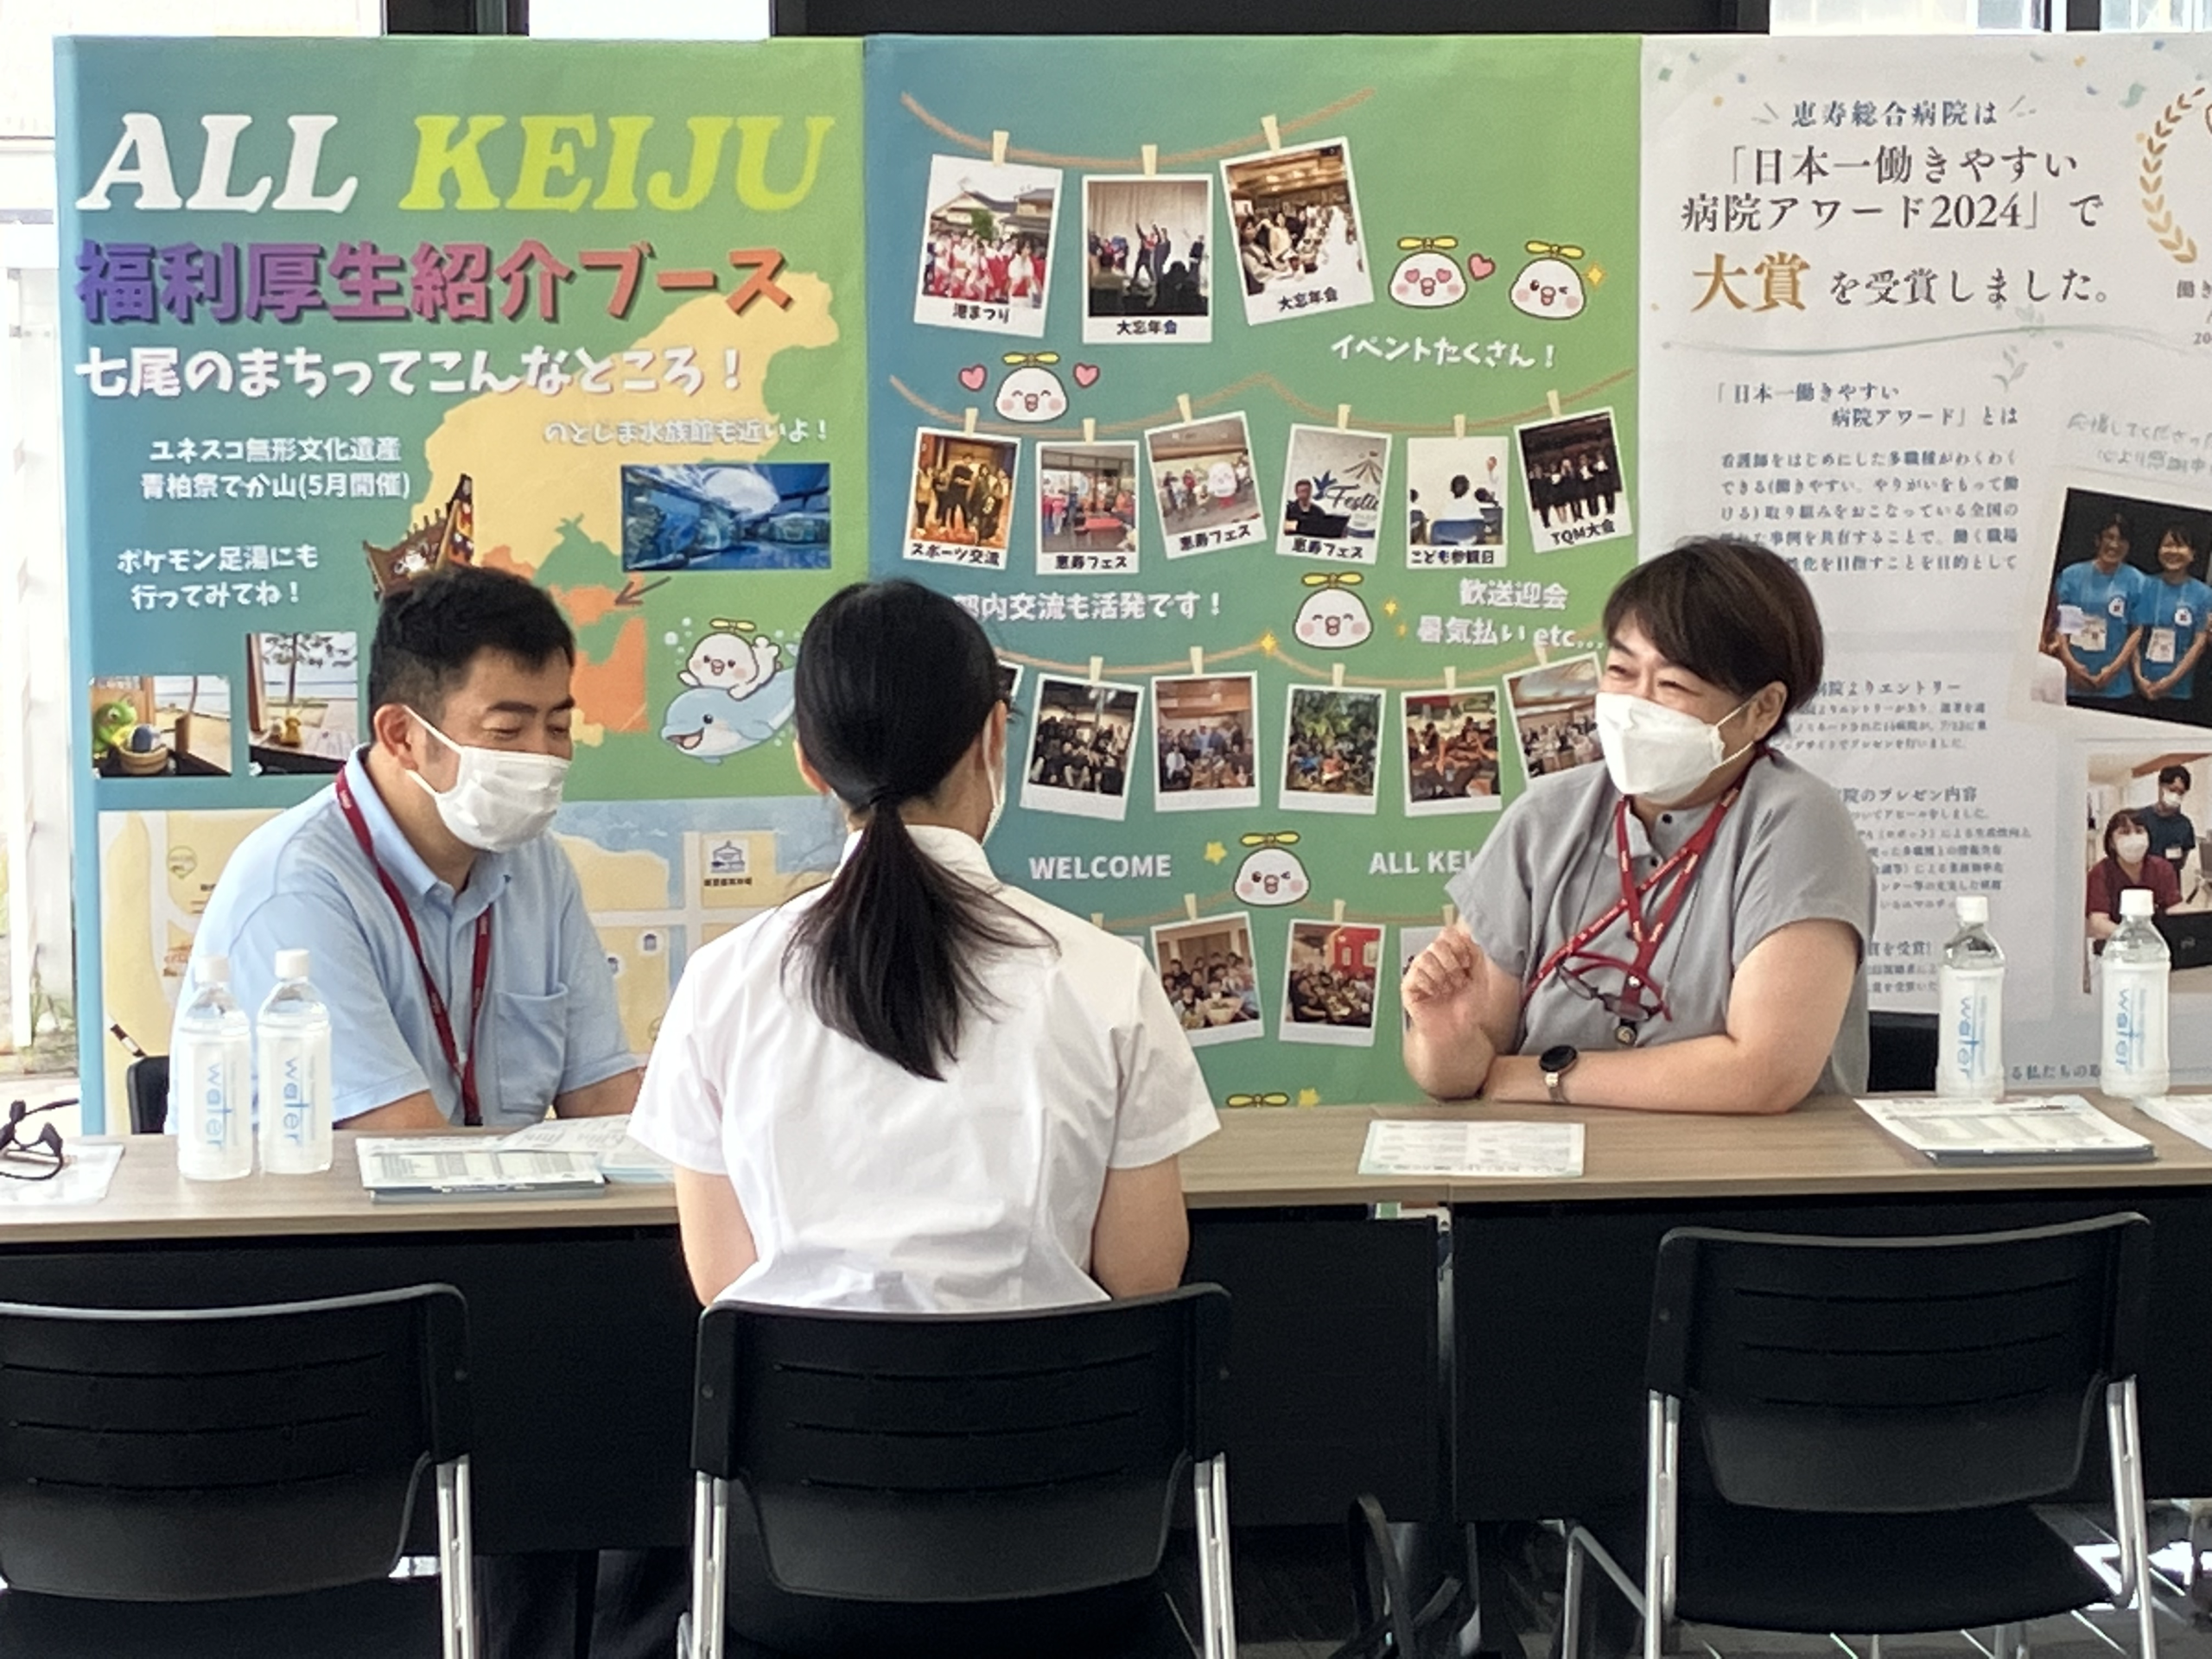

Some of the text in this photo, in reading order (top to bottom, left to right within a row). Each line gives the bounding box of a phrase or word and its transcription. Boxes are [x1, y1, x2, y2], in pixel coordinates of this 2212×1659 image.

[1791, 100, 1998, 129] 恵寿総合病院は
[75, 113, 837, 213] ALL KEIJU
[1732, 143, 2078, 186] 「日本一働きやすい
[75, 240, 795, 324] 福利厚生紹介ブース
[1690, 251, 2109, 314] 大賞 を受賞しました。
[1116, 320, 1179, 337] 大忘年会
[1331, 334, 1557, 369] イベントたくさん！
[75, 346, 743, 398] 七尾のまちってこんなところ！
[1715, 382, 1900, 404] 「日本一働きやすい
[1831, 405, 2019, 429] 病院アワード」とは
[149, 435, 402, 463] ユネスコ無形文化遺産
[1551, 518, 1616, 546] TQM大会
[117, 543, 319, 574] ポケモン足湯にも
[910, 542, 1001, 568] スポーツ交流
[130, 581, 300, 609] 行ってみてね！
[1459, 577, 1569, 610] 歓送迎会
[1417, 614, 1526, 646] 暑気払い
[1028, 853, 1173, 880] WELCOME
[1368, 851, 1421, 875] ALL
[1957, 995, 1980, 1077] water
[2114, 988, 2139, 1070] water
[206, 1062, 233, 1150] water
[283, 1057, 310, 1147] water
